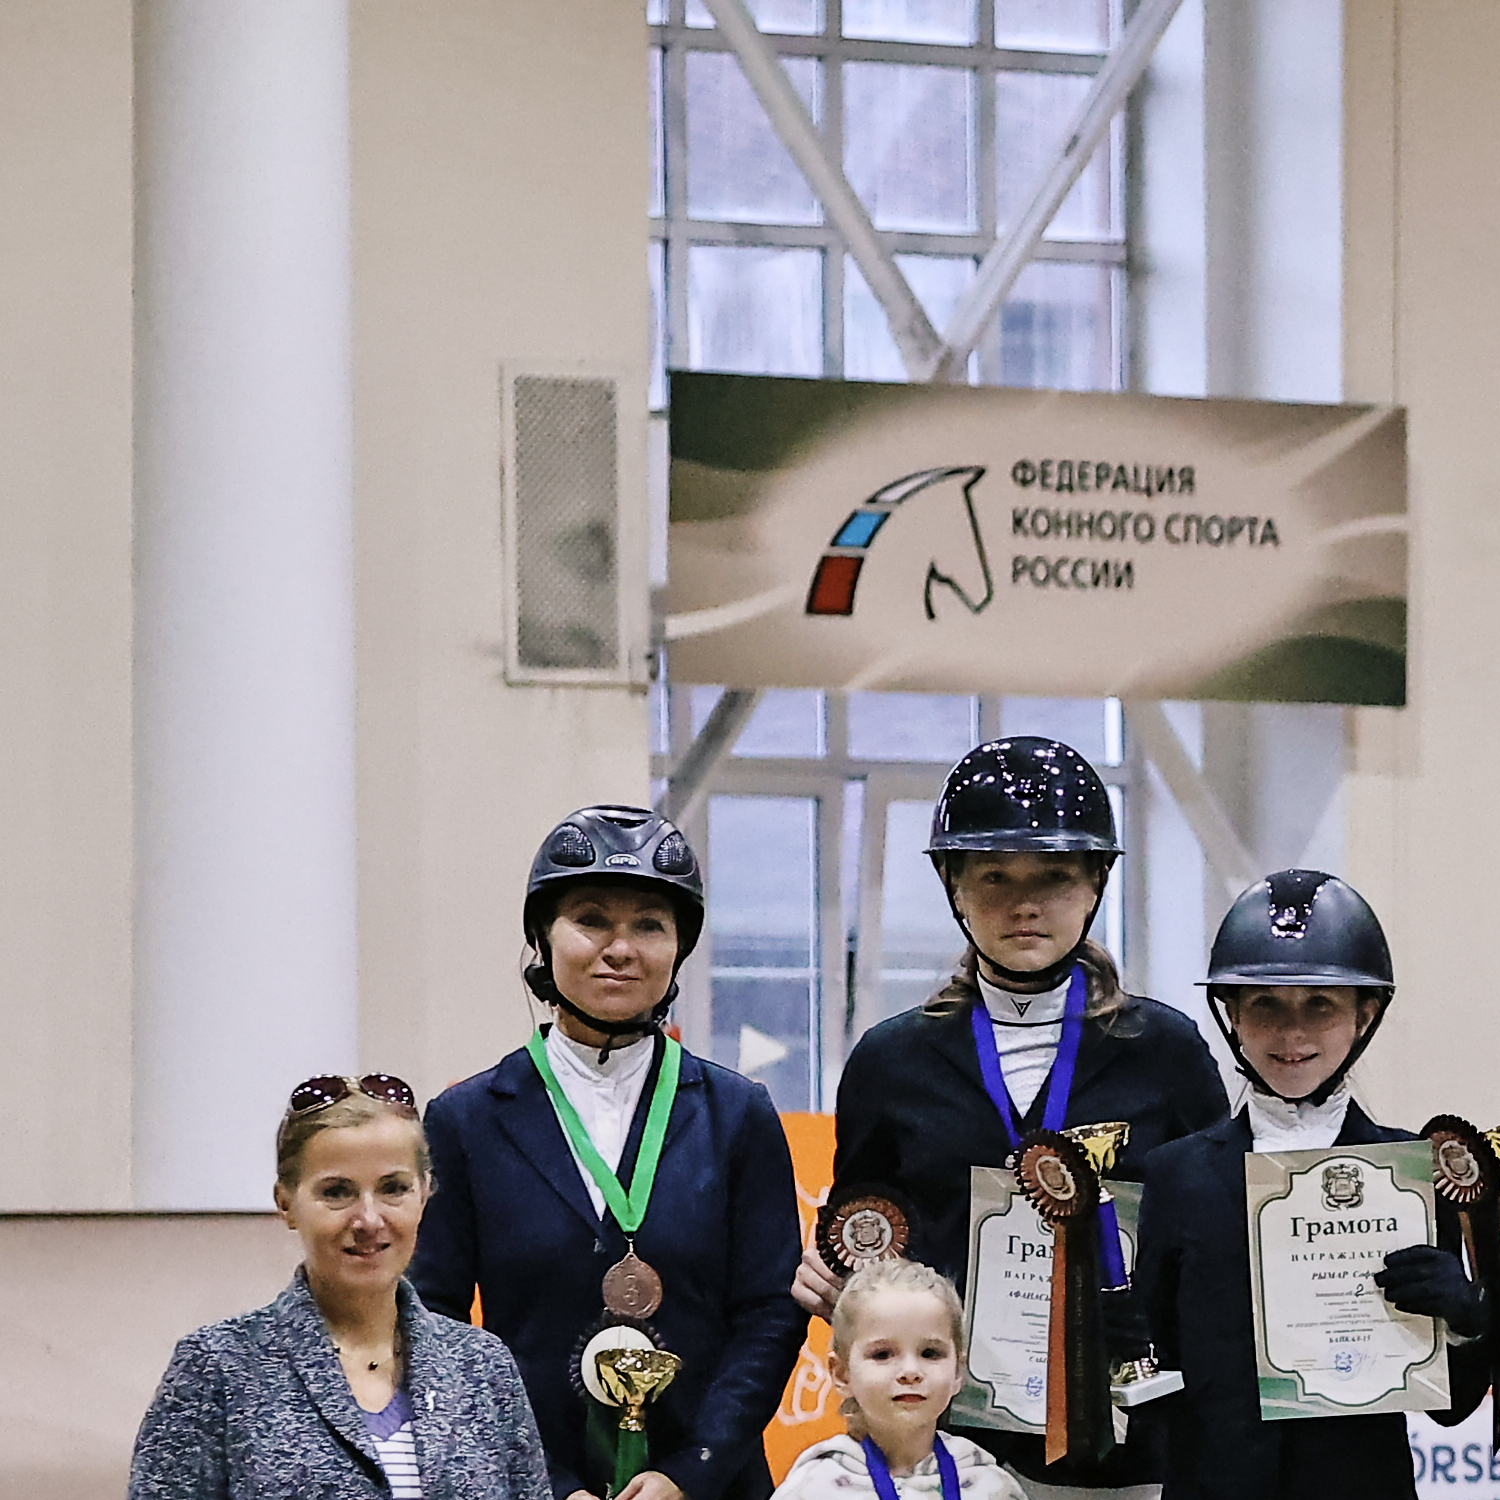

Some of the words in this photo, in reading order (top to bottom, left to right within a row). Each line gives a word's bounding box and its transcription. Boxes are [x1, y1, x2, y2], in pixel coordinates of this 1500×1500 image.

[1011, 458, 1197, 497] ФЕДЕРАЦИЯ
[1011, 508, 1155, 543] КОННОГО
[1164, 511, 1280, 548] СПОРТА
[1011, 556, 1135, 590] РОССИИ
[1290, 1217, 1398, 1243] Грамота
[1291, 1250, 1391, 1262] НАГРАЖДАЕТС
[1311, 1271, 1350, 1281] РЫМАР
[1354, 1283, 1364, 1298] 2
